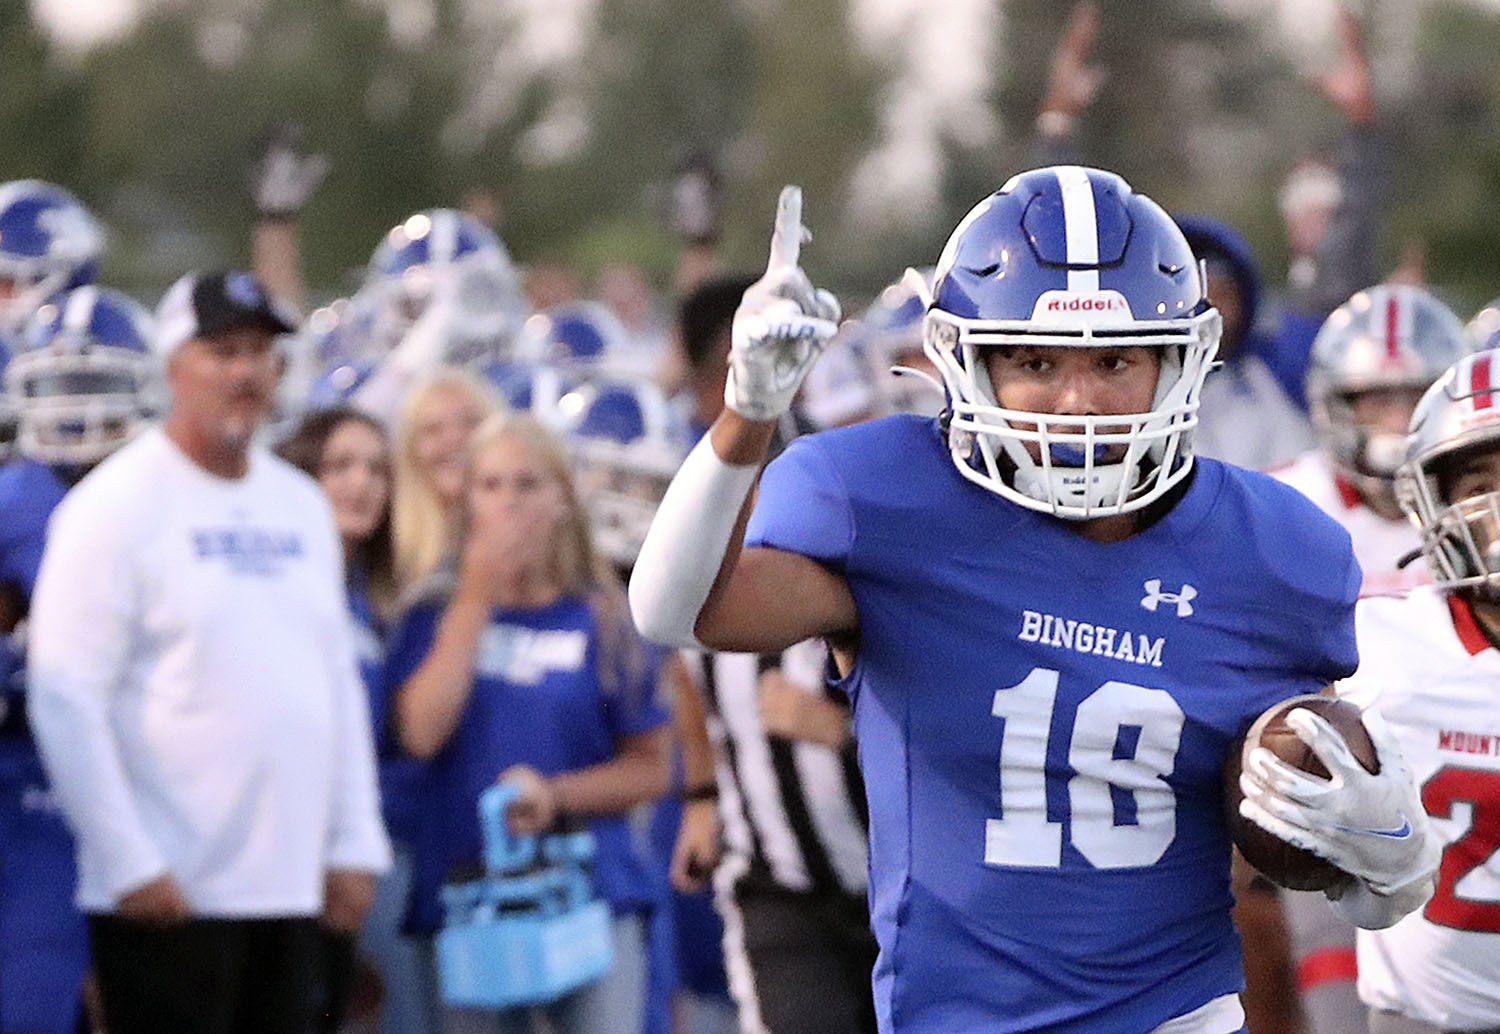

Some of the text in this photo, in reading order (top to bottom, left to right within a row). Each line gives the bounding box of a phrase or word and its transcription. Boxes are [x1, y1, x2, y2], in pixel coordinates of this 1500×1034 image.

[1047, 298, 1120, 311] Riddel
[1018, 610, 1166, 667] BINGHAM
[984, 667, 1186, 870] 18
